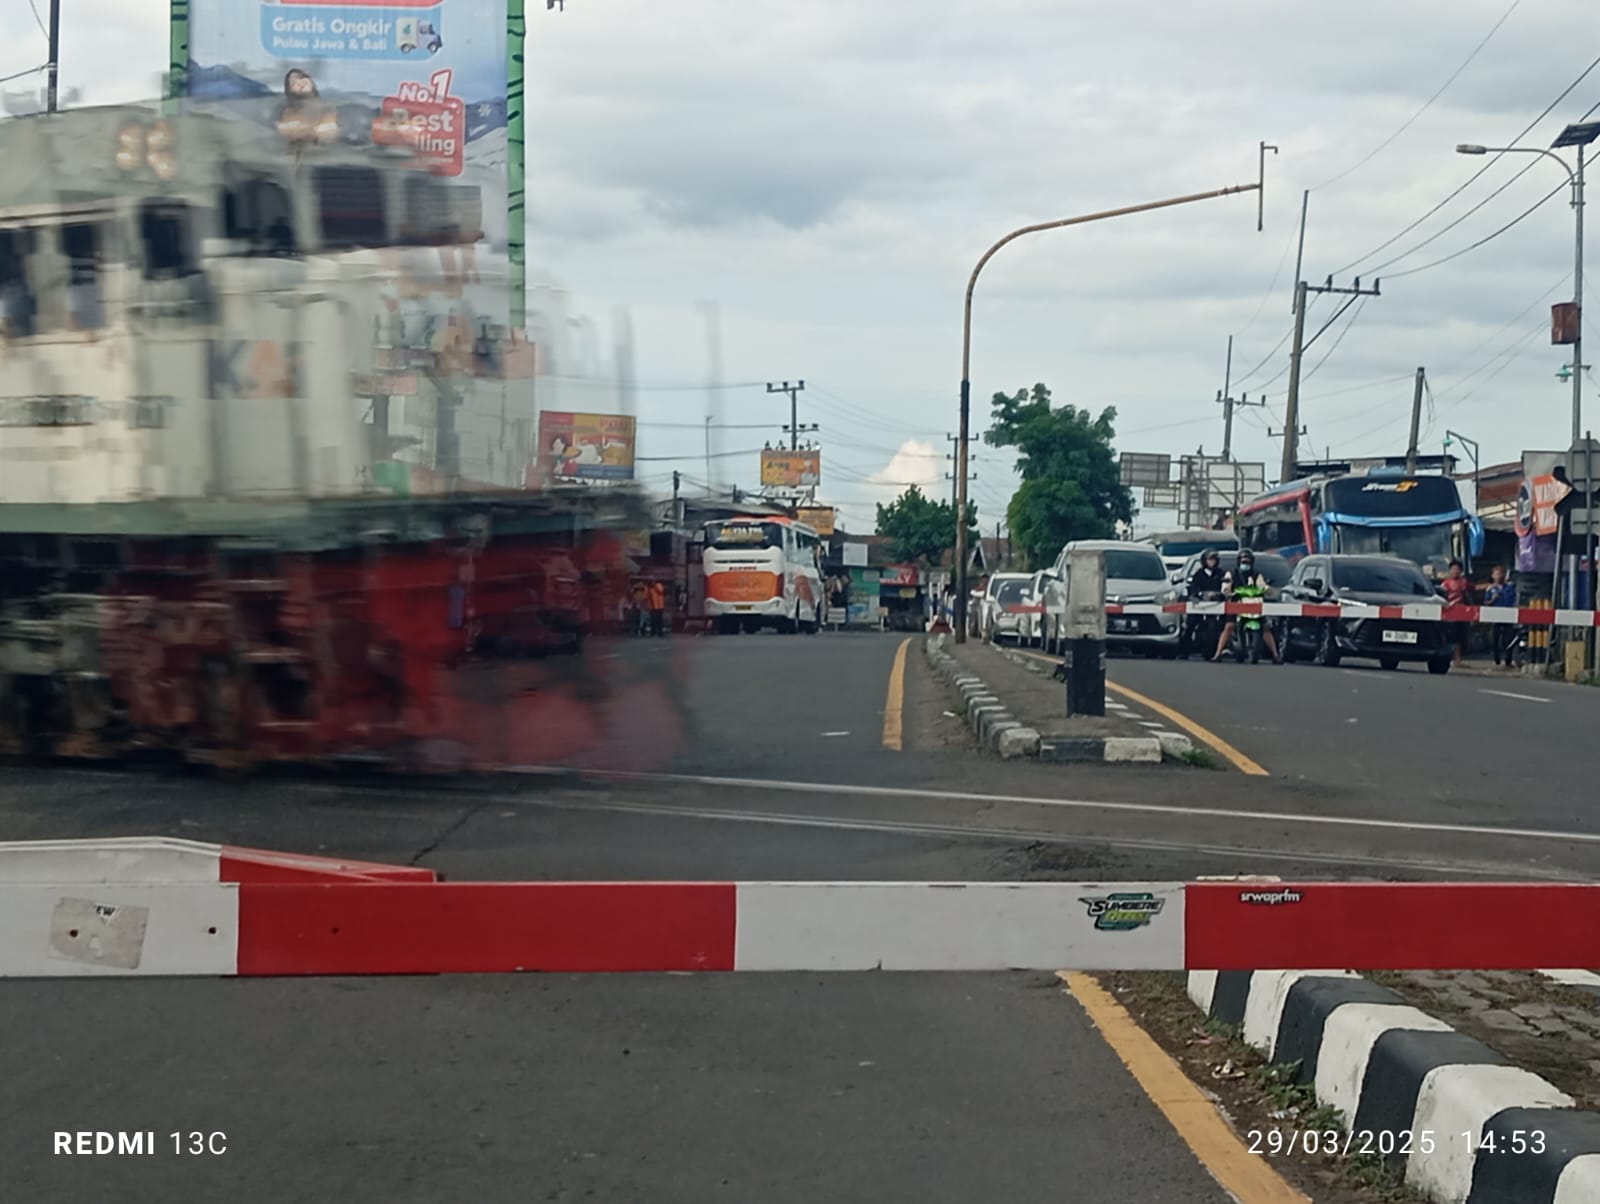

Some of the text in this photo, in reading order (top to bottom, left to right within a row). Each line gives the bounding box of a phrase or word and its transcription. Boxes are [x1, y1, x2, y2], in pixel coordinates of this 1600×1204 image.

[272, 16, 392, 37] Gratis Ongkir
[273, 37, 387, 50] Pulau Jawa & Bali
[399, 70, 450, 103] No.1
